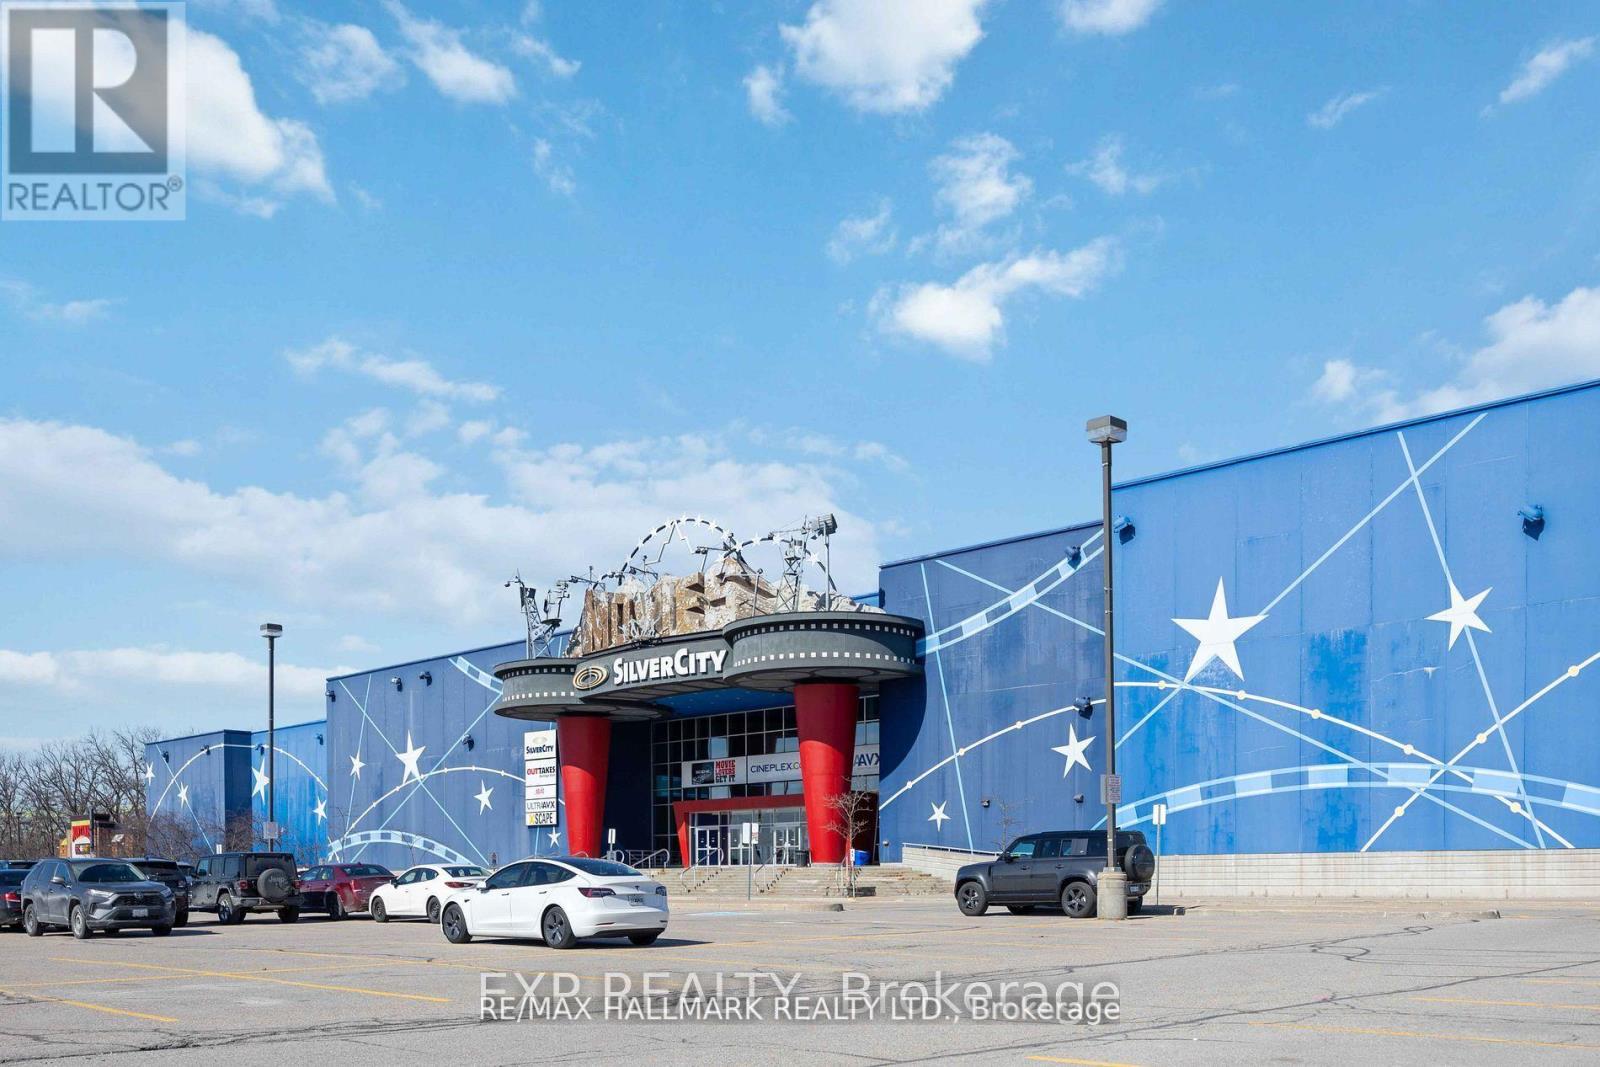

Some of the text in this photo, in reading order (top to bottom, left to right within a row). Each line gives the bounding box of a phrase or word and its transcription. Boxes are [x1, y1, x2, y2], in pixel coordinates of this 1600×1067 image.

[716, 760, 736, 769] MOVIE
[716, 775, 736, 784] GET IT
